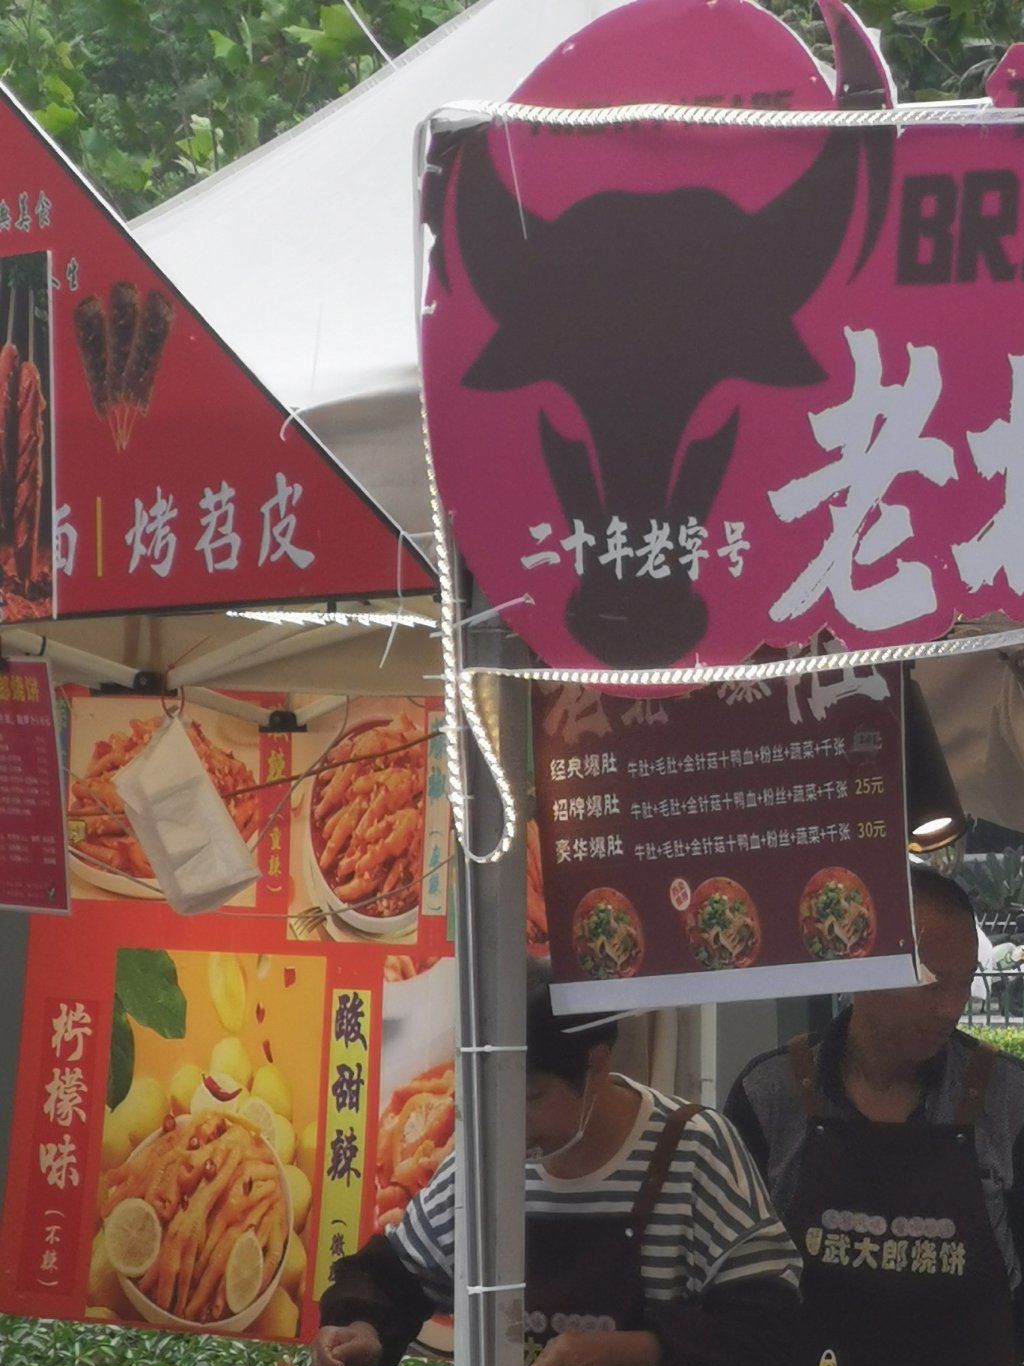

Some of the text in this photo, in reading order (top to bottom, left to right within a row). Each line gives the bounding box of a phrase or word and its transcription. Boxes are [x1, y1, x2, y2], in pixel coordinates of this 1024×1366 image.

[124, 472, 316, 577] 烤苕皮
[520, 516, 750, 581] 二十年老字号
[553, 793, 620, 822] 招牌爆肚
[855, 776, 885, 796] 25元
[555, 834, 624, 864] 豪华爆肚
[857, 820, 887, 839] 30元
[38, 1002, 92, 1190] 柠檬味
[822, 1233, 966, 1276] 武大郎烧饼
